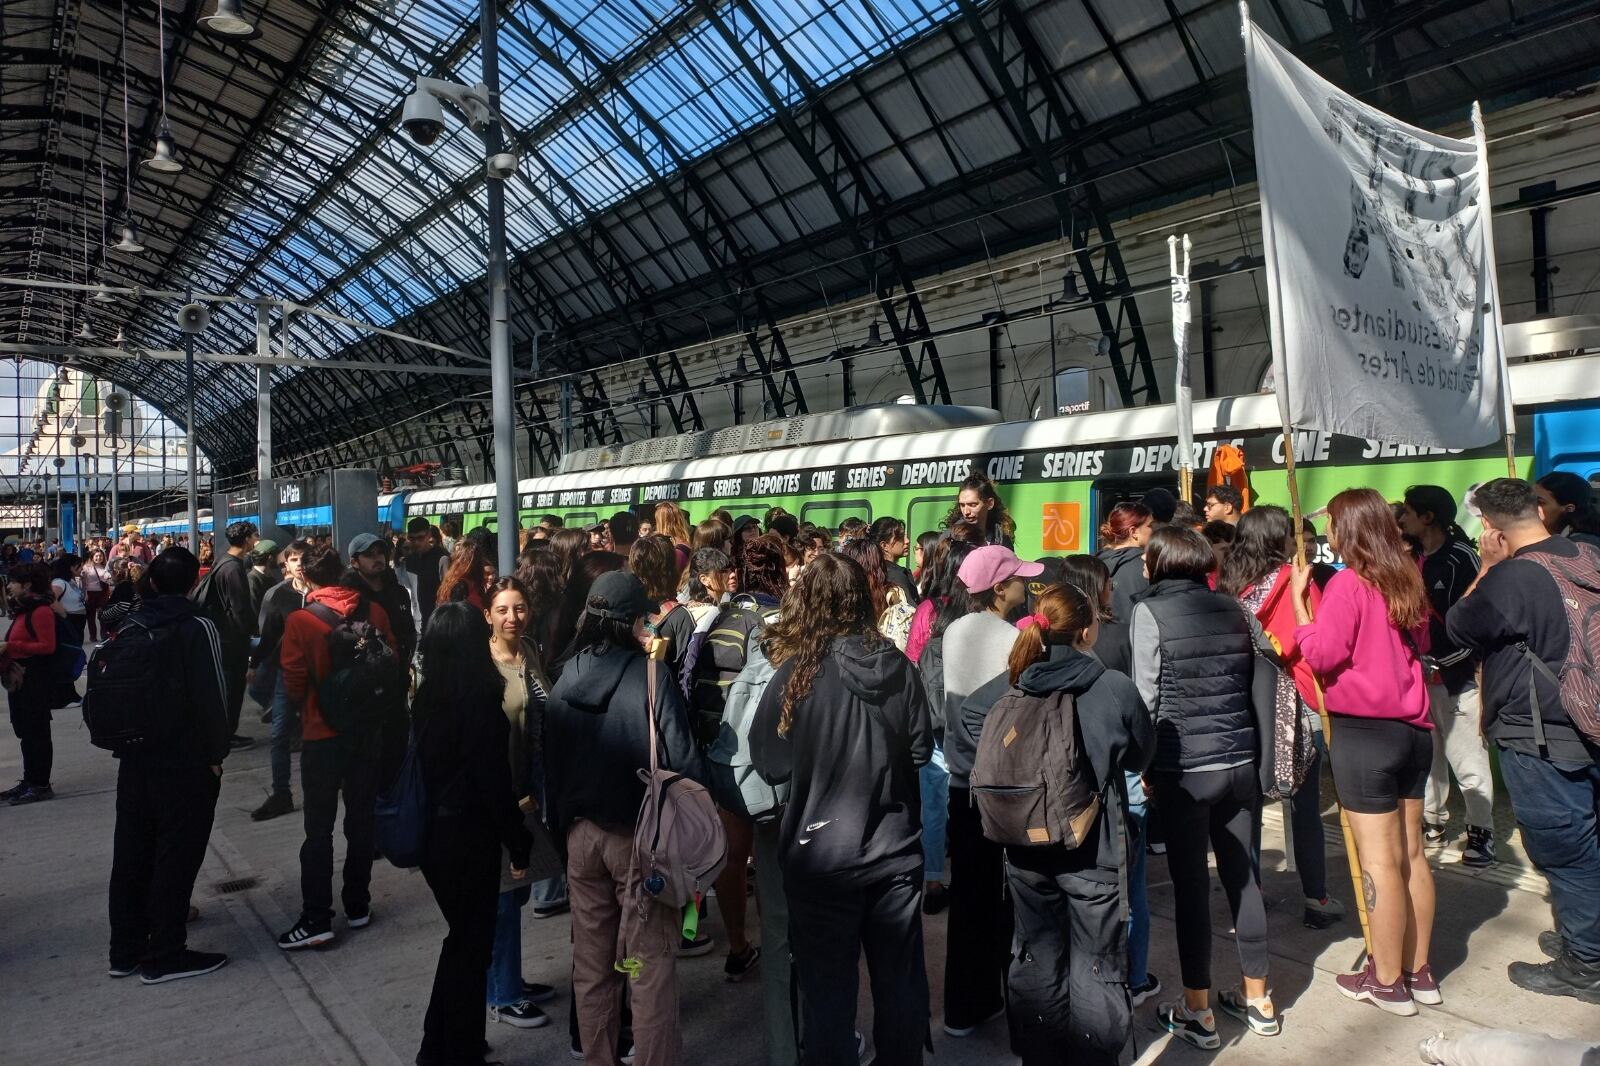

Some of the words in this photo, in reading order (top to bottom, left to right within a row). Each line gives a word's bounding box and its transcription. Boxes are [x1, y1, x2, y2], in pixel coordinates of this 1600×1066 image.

[644, 484, 680, 501] DEPORTES
[686, 480, 706, 499] CINE
[712, 478, 742, 497] SERIES
[751, 474, 801, 495] DEPORTES
[810, 470, 836, 492] CINE
[846, 465, 888, 489] SERIES
[900, 459, 972, 486] DEPORTES
[986, 455, 1024, 481] CINE
[1041, 450, 1104, 479] SERIES
[280, 485, 287, 505] La
[286, 484, 300, 503] Plata
[558, 491, 587, 506] DEPORTES
[591, 489, 606, 505] CINE
[610, 487, 632, 504] SERIES
